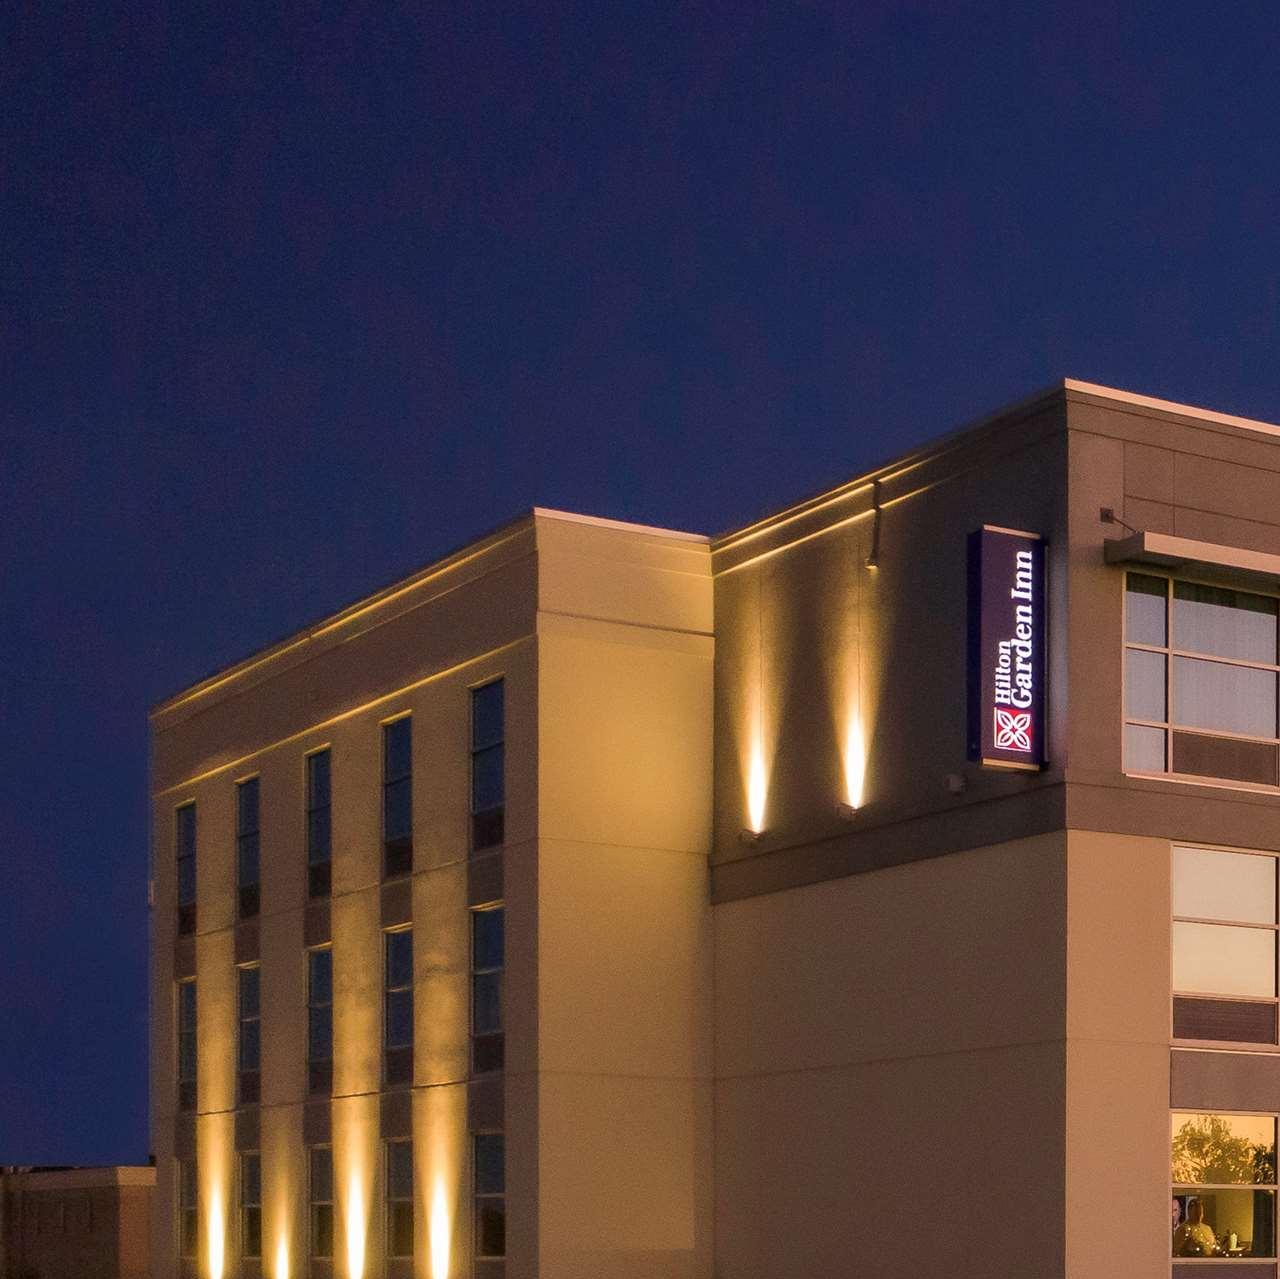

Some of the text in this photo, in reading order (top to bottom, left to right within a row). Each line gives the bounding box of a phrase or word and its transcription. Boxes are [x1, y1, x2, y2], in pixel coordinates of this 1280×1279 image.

[995, 640, 1011, 705] Hilton
[1010, 550, 1032, 709] Garden Inn
